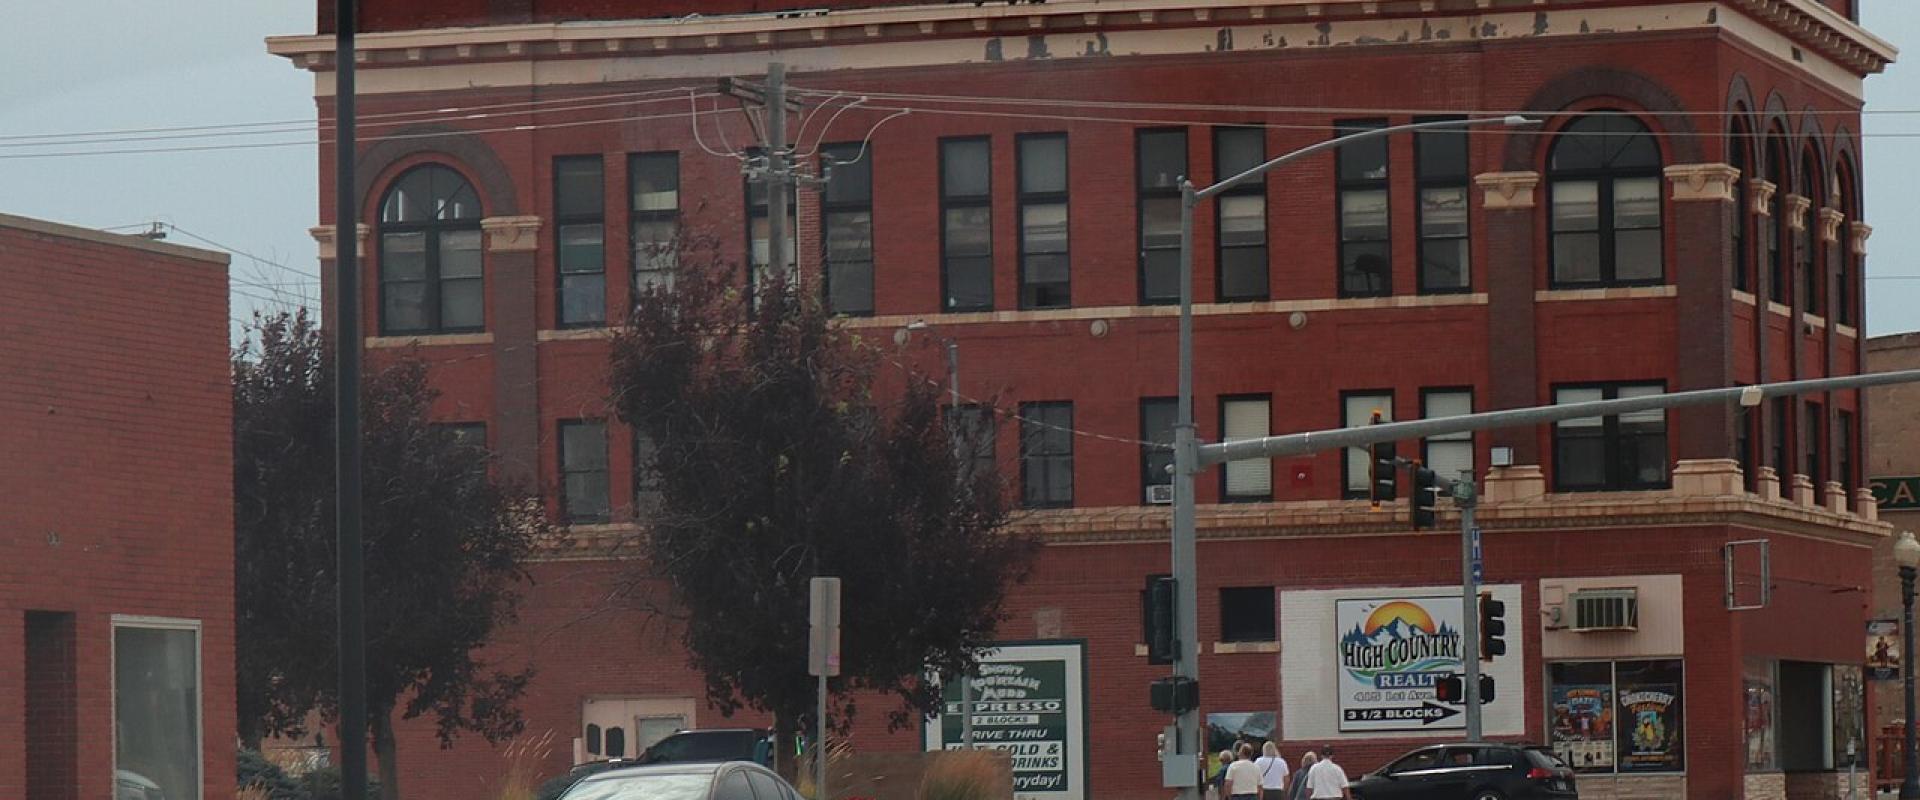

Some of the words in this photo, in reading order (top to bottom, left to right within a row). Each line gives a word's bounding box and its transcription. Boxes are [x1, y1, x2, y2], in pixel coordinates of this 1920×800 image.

[1344, 641, 1384, 668] HIGH
[1388, 634, 1459, 665] COUNTRY
[1381, 673, 1450, 687] REALT
[1354, 690, 1380, 701] 415
[947, 702, 1060, 712] EPRESSO
[987, 715, 1028, 724] BLOCKS
[1347, 710, 1356, 720] 3
[1361, 710, 1382, 719] 1/2
[1386, 709, 1444, 719] BLOCKS
[960, 730, 1004, 740] RIVE
[1008, 729, 1048, 739] THRU
[1047, 743, 1059, 755] &
